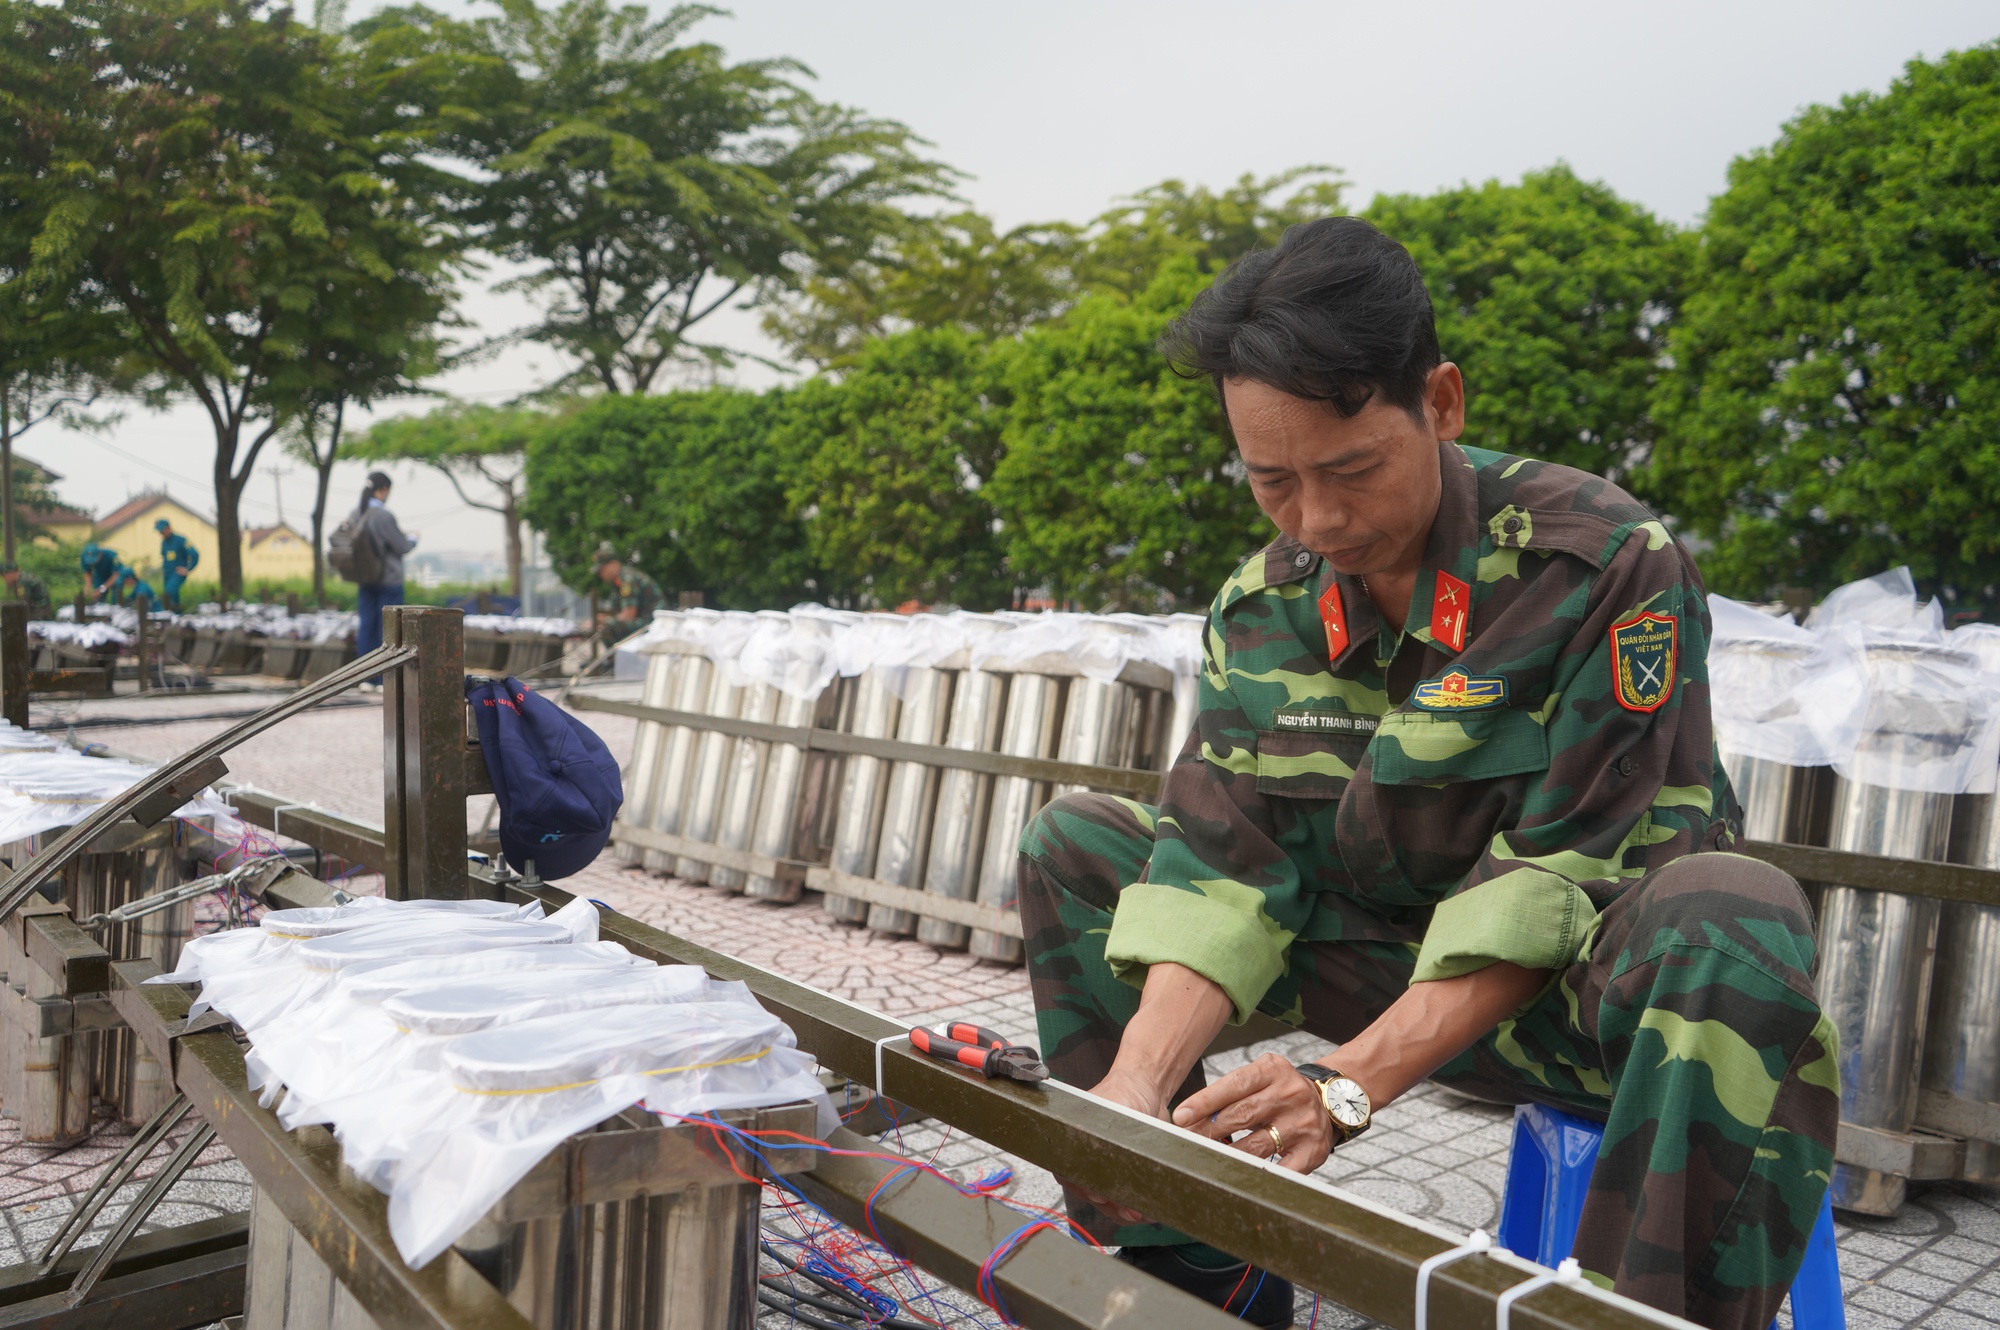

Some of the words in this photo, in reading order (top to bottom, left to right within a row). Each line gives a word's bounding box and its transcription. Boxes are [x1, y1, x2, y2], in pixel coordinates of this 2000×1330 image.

[1620, 635, 1638, 646] QUÂN
[1650, 644, 1662, 652] NAM
[1278, 712, 1317, 726] NGUYỄN
[1320, 716, 1352, 728] THANH
[1354, 718, 1378, 730] BÌNH
